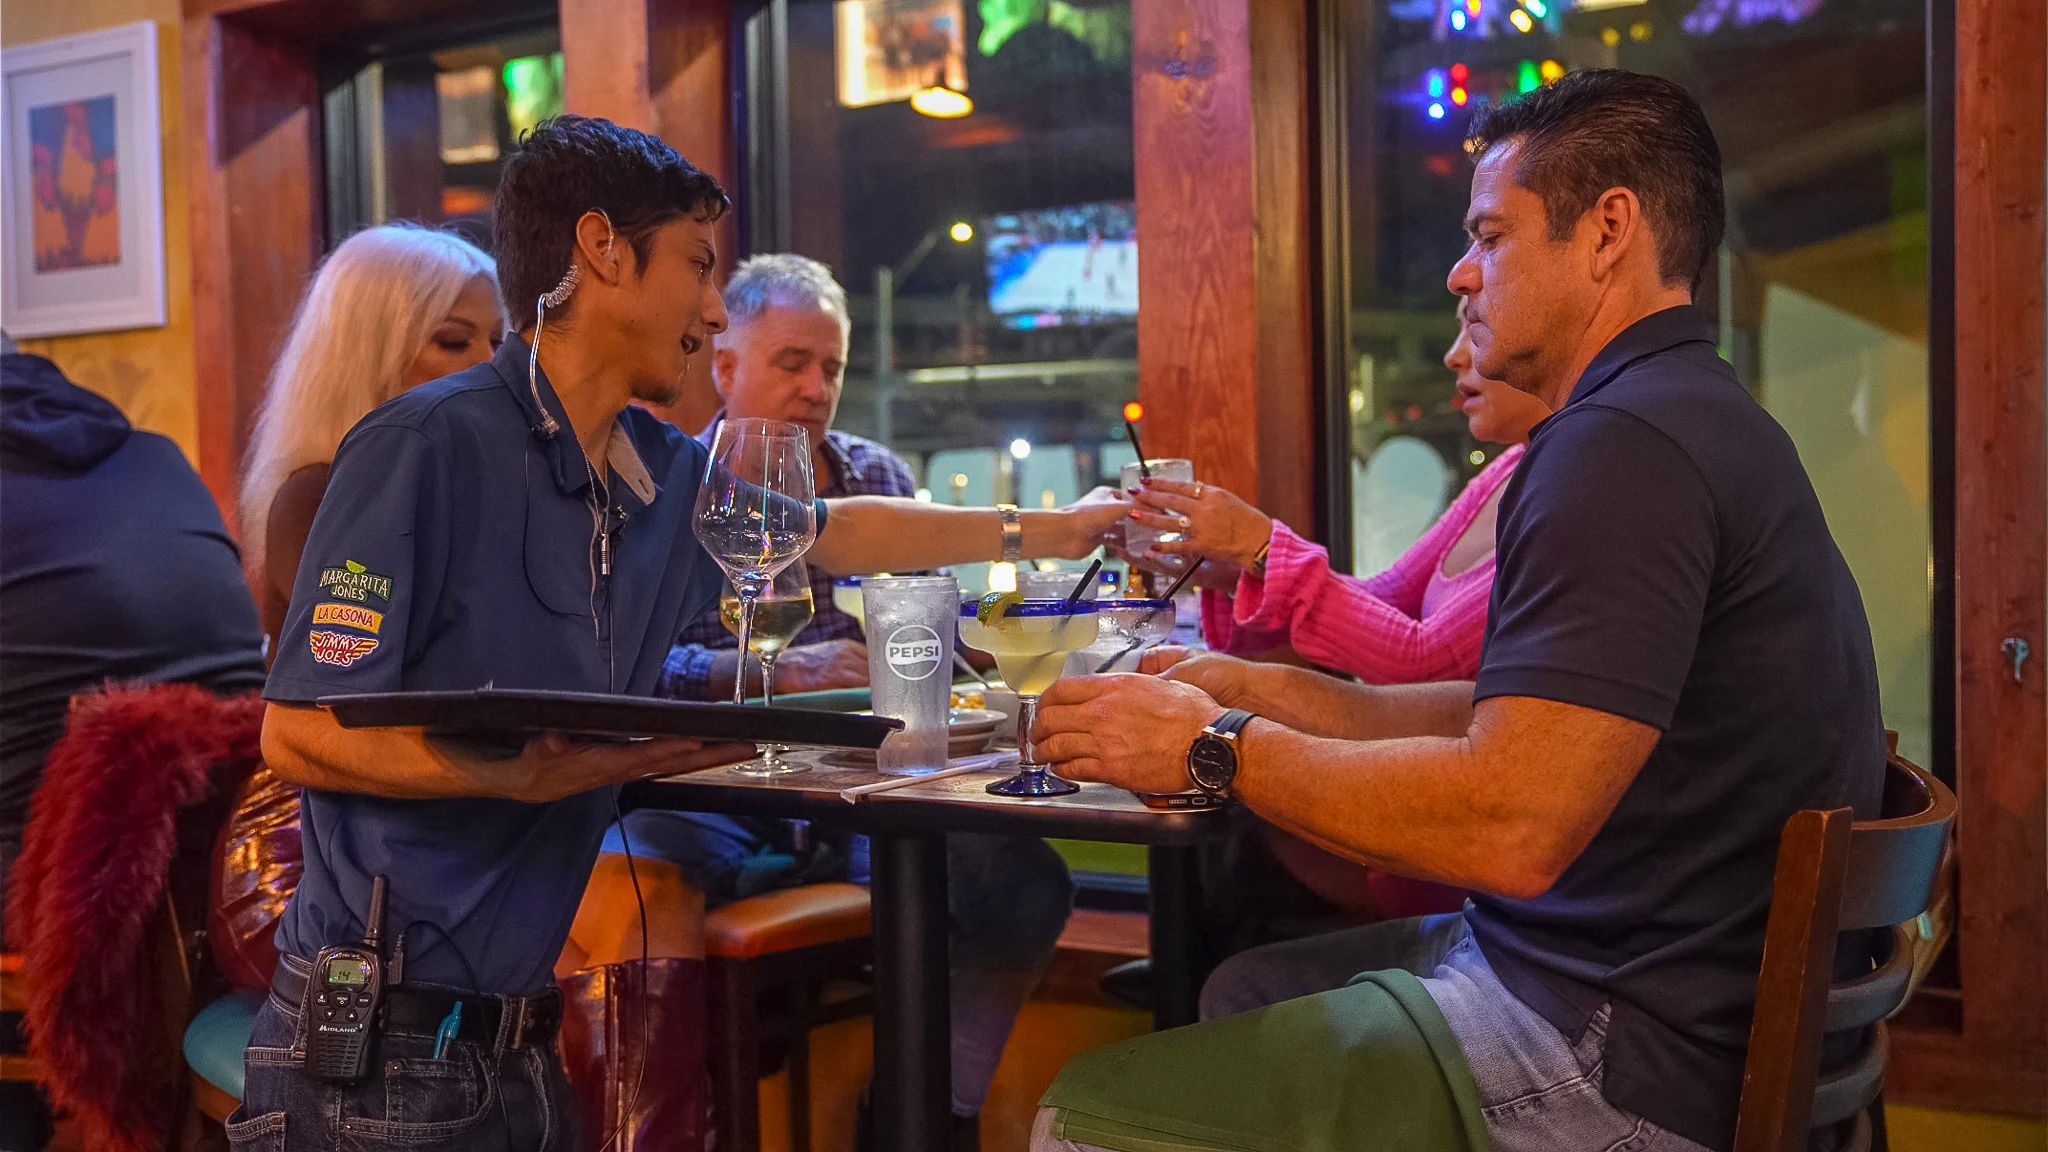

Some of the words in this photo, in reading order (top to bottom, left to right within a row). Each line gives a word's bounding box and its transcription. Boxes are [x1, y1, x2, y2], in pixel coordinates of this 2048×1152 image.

[319, 570, 388, 598] MARGARITA
[332, 585, 365, 601] JONES
[317, 607, 329, 620] LA
[330, 606, 374, 628] CASONA
[317, 649, 351, 664] JOE'S
[889, 645, 939, 658] PEPSI
[337, 970, 351, 981] 14
[319, 1024, 356, 1033] MIDLAND
